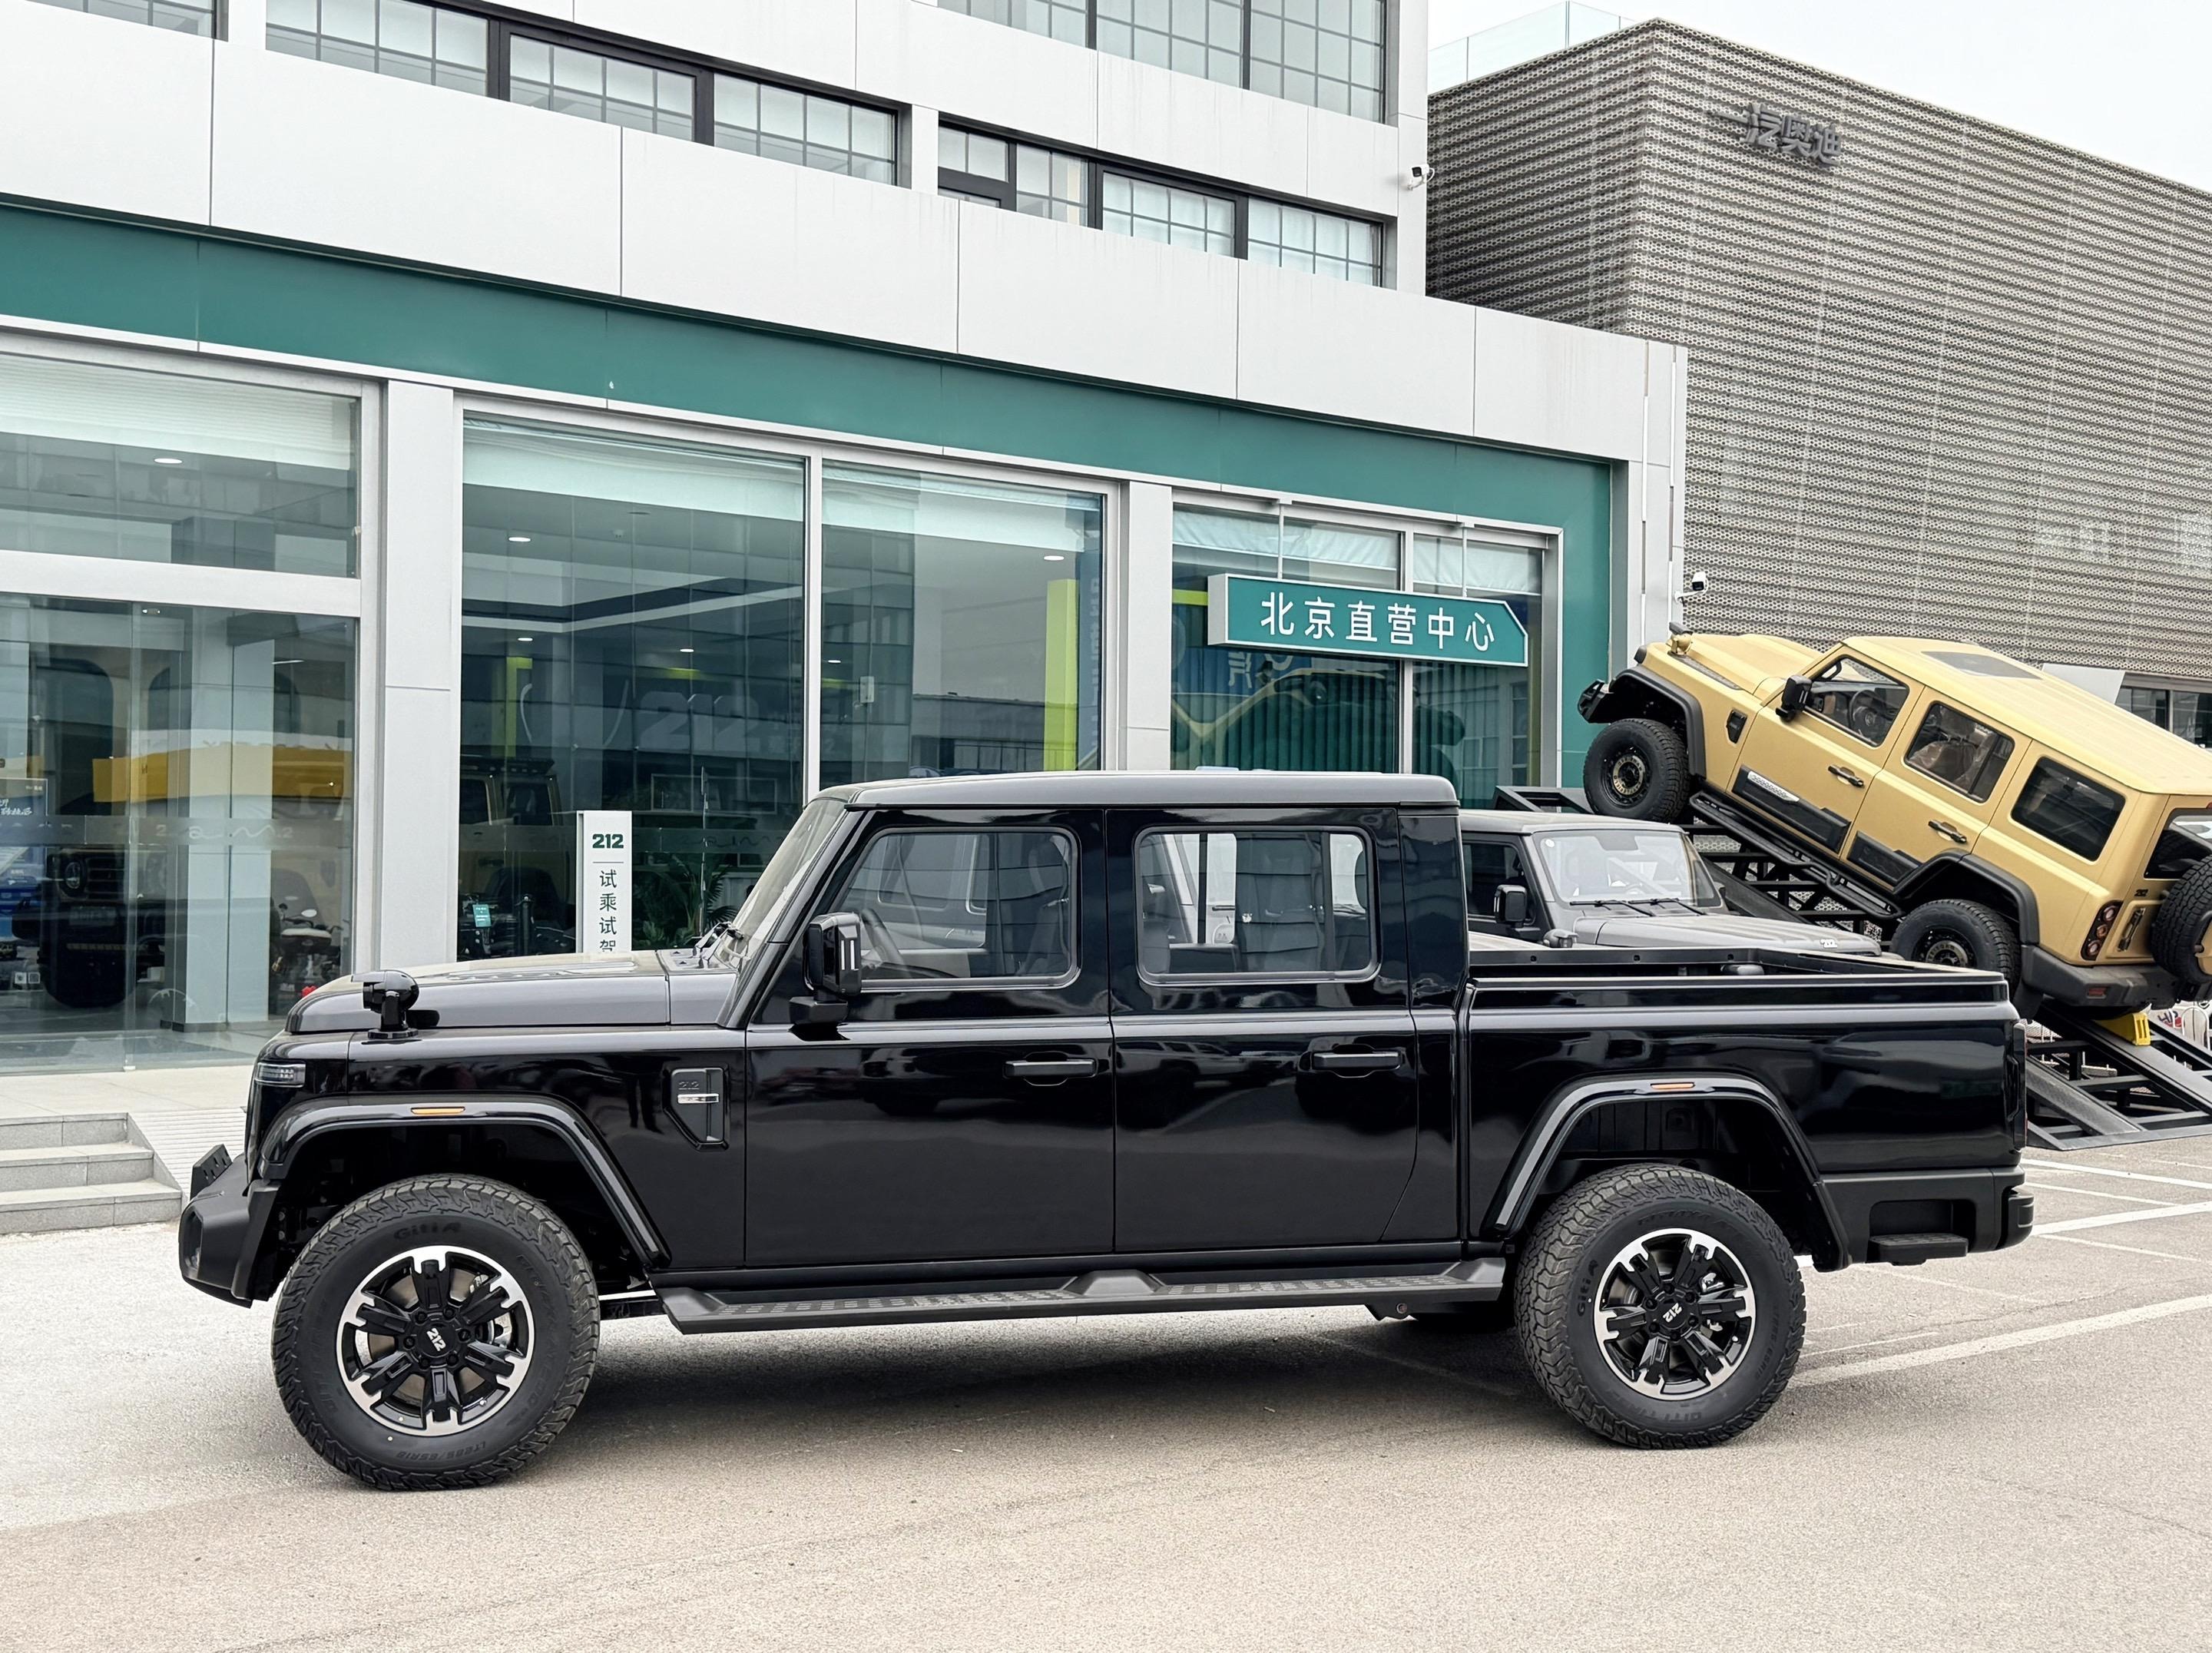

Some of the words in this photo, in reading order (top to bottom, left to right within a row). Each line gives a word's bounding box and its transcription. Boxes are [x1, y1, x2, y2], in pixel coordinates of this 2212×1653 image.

[1707, 103, 1842, 166] 一汽奥迪
[1260, 591, 1495, 652] 北京直营中心
[592, 833, 624, 849] 212
[1662, 1302, 1683, 1323] 212
[426, 1327, 446, 1352] 212
